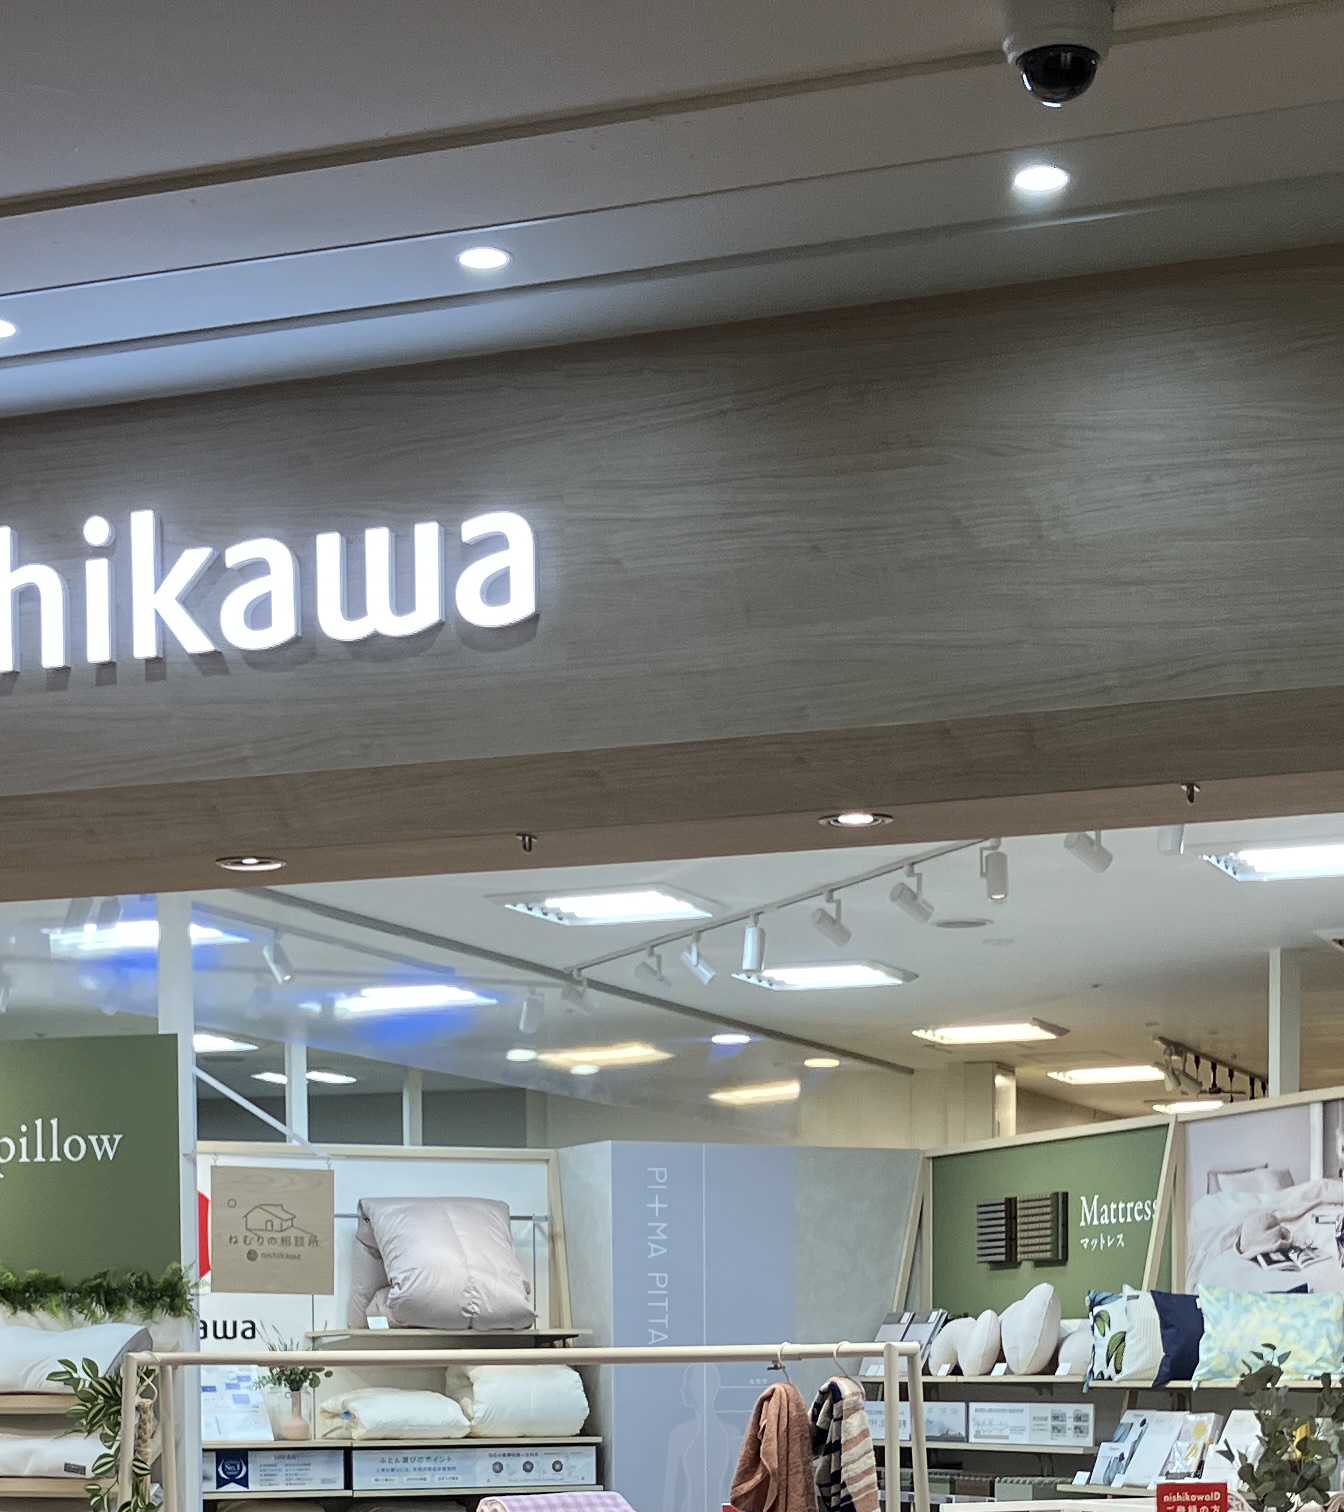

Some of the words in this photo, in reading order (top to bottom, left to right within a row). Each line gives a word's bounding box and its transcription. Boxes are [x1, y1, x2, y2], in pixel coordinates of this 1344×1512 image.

[1079, 1232, 1125, 1252] マットレス
[260, 1251, 301, 1261] nishikawa
[1163, 1491, 1221, 1503] nishikawaID
